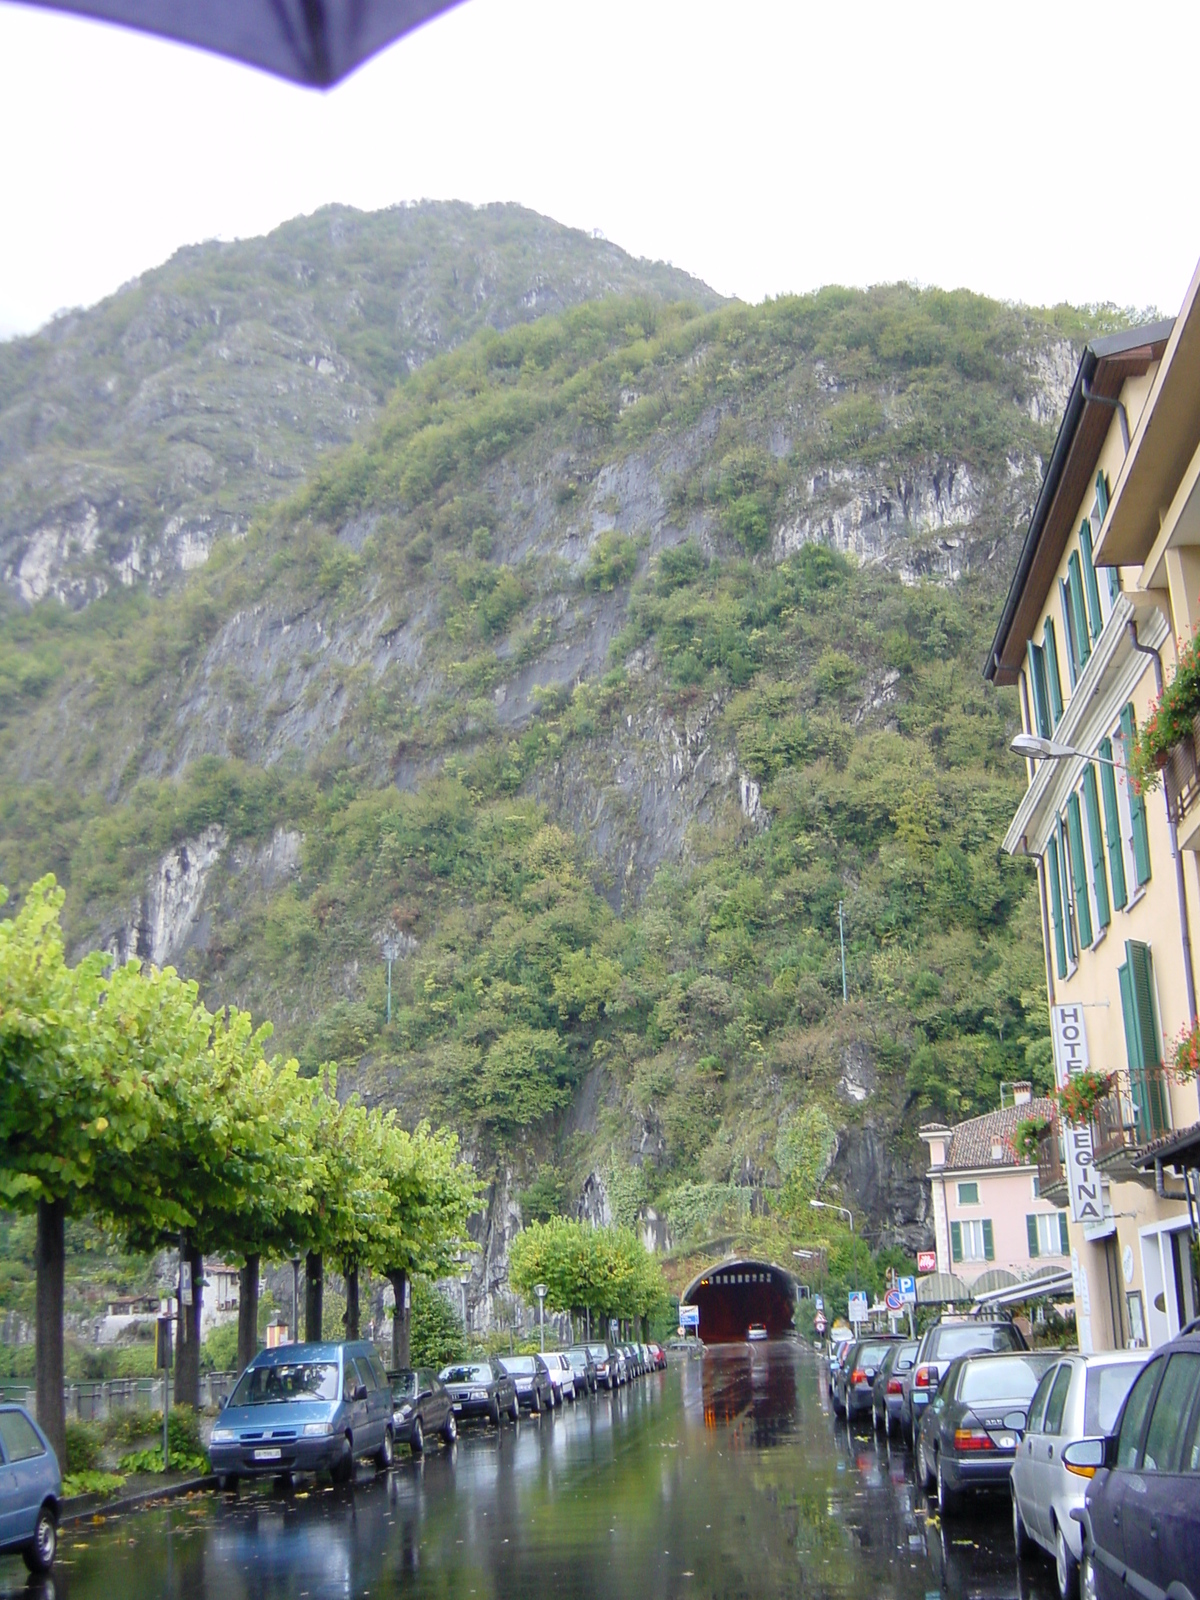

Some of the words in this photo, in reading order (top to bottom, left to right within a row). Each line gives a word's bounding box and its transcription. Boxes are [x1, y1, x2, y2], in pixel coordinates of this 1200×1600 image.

[1060, 1008, 1083, 1080] HOTE
[920, 1255, 935, 1269] illy
[900, 1278, 912, 1293] P
